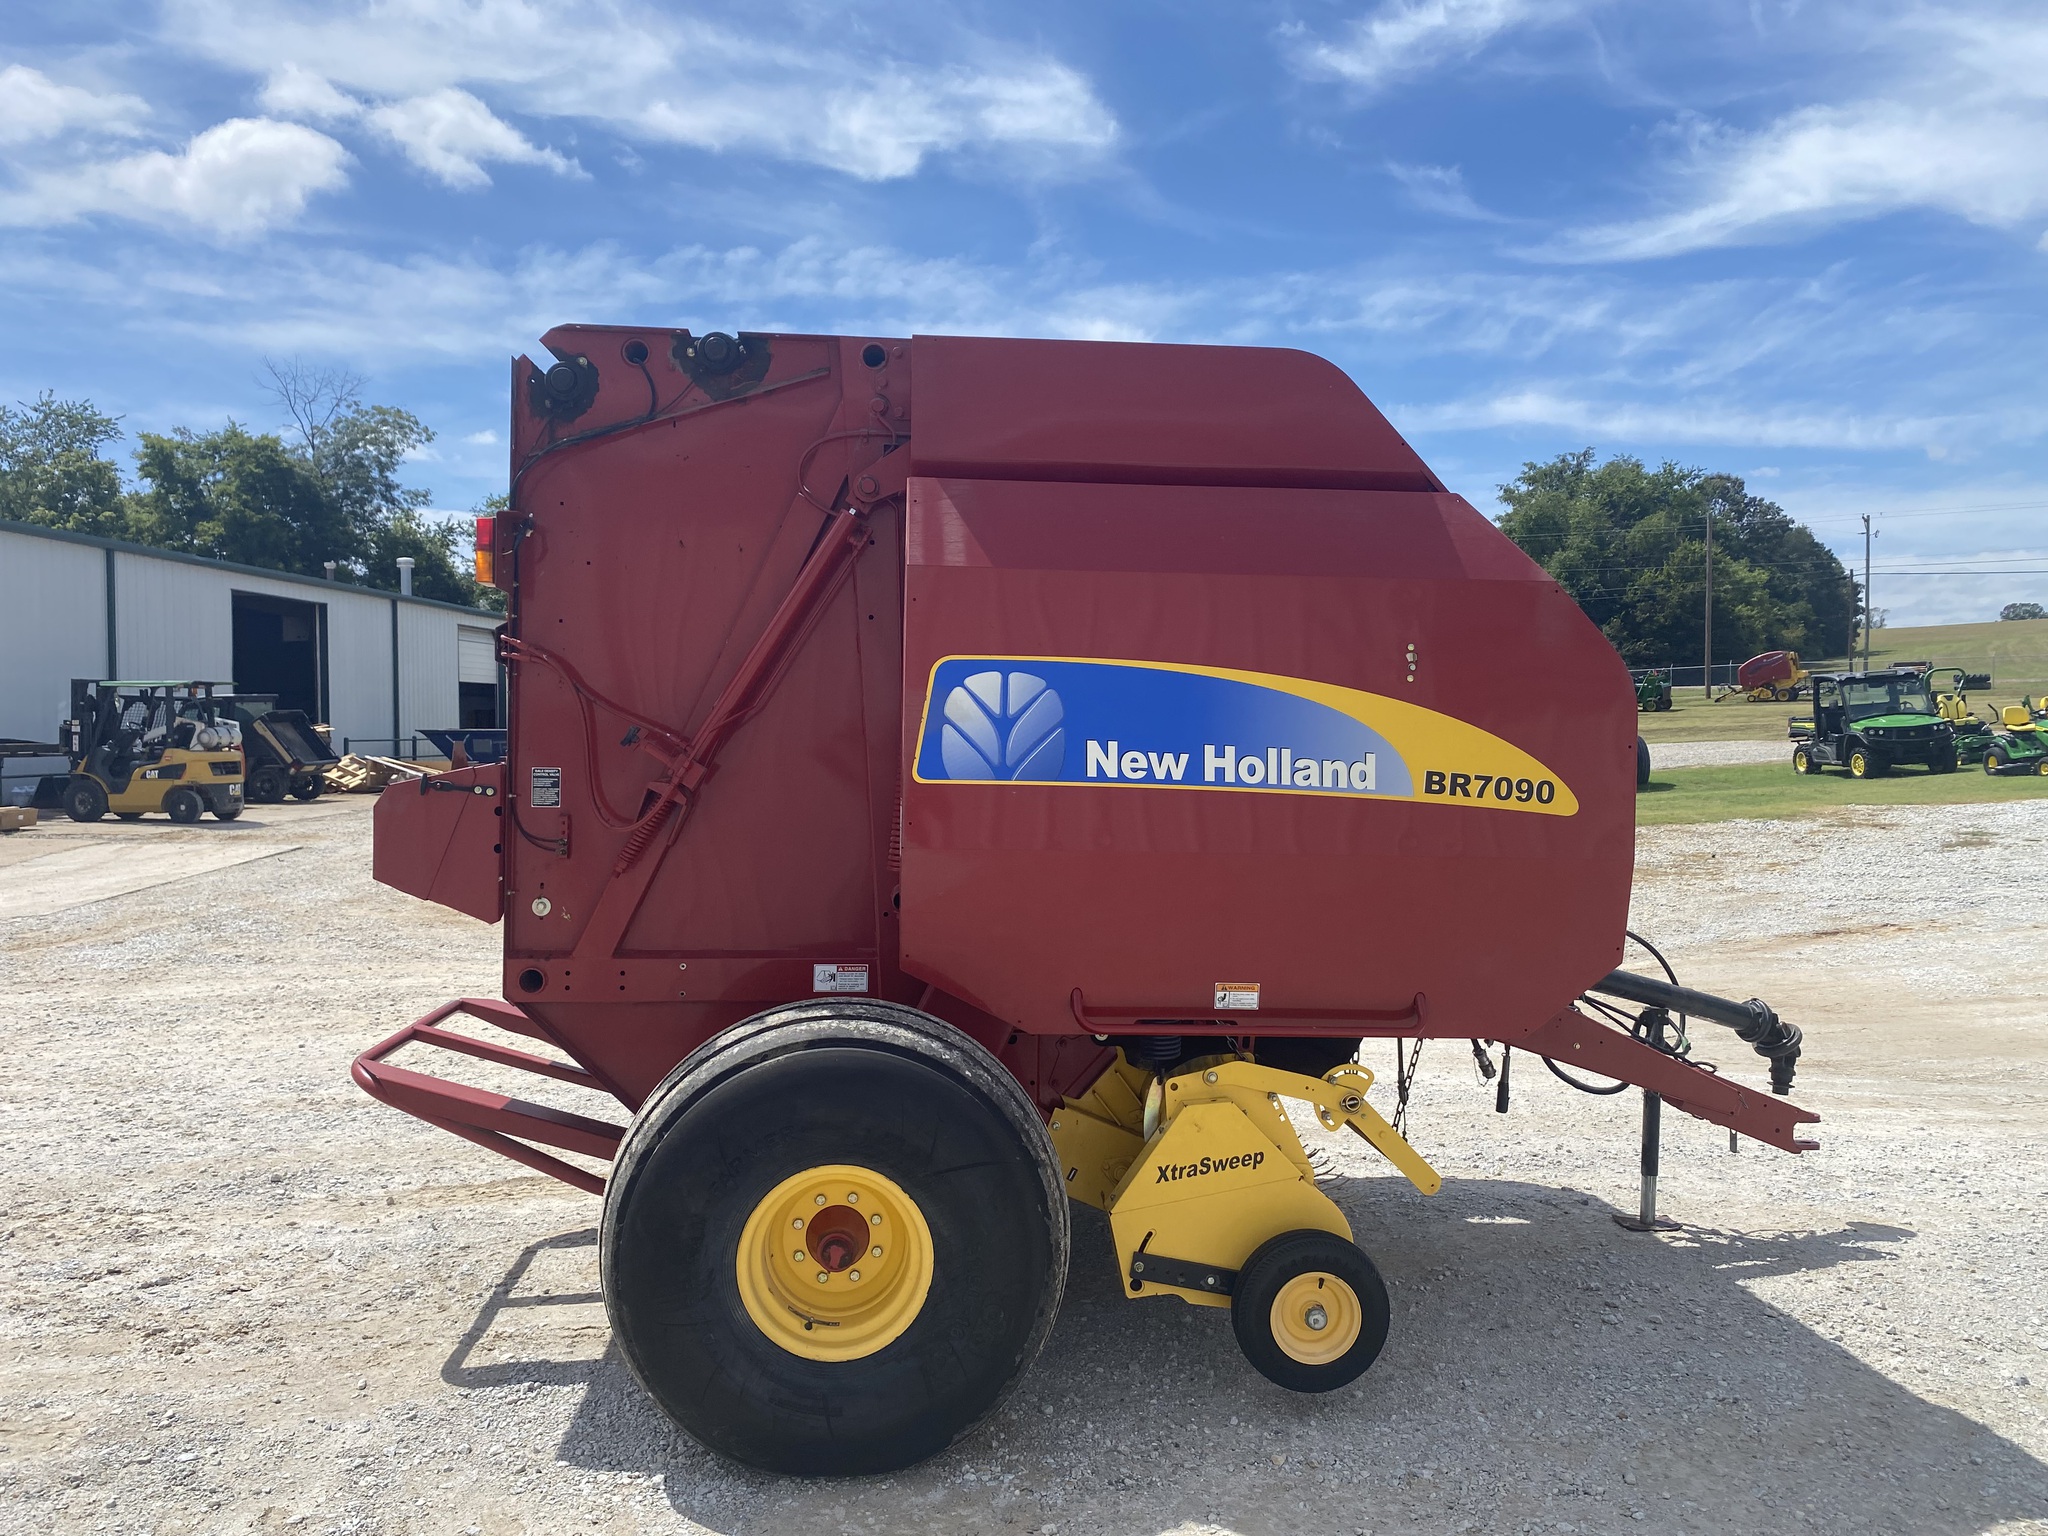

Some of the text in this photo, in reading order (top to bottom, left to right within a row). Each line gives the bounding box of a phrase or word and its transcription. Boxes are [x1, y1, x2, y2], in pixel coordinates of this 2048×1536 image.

[145, 769, 159, 779] CAT
[1085, 739, 1377, 790] New Holland
[229, 784, 241, 796] CAT
[1424, 769, 1556, 805] BR7090
[1155, 1150, 1265, 1184] XtraSweep
